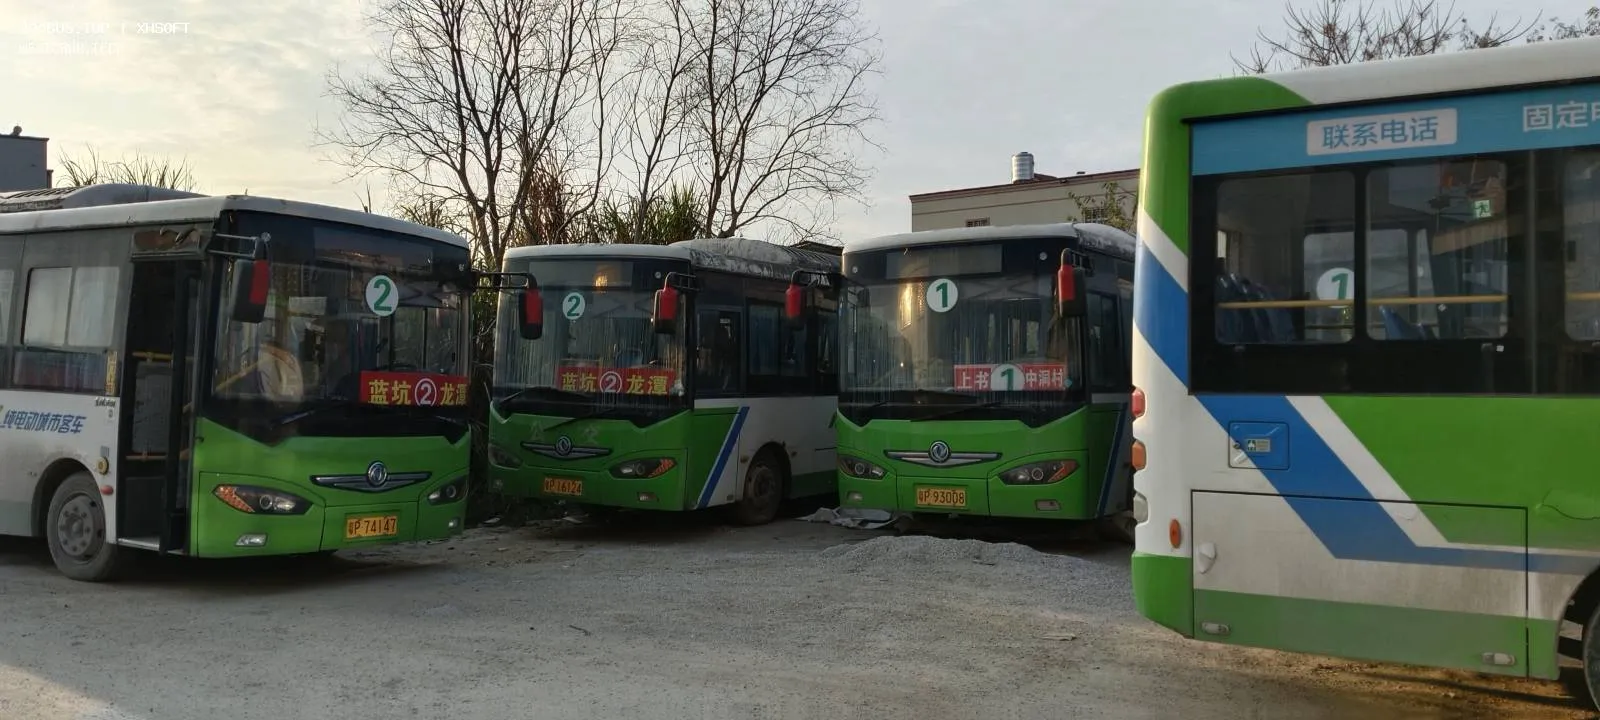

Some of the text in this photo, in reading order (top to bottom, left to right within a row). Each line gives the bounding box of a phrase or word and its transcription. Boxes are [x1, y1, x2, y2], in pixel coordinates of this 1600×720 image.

[1523, 100, 1600, 132] 固定
[1322, 116, 1439, 149] 联系电话
[373, 278, 392, 312] 2
[935, 282, 949, 308] 1
[1331, 272, 1349, 300] 1
[566, 295, 581, 317] 2
[368, 379, 411, 405] 蓝坑
[561, 372, 597, 393] 蓝坑
[626, 374, 668, 395] 龙潭
[3, 409, 87, 434] 纯电动城市客车
